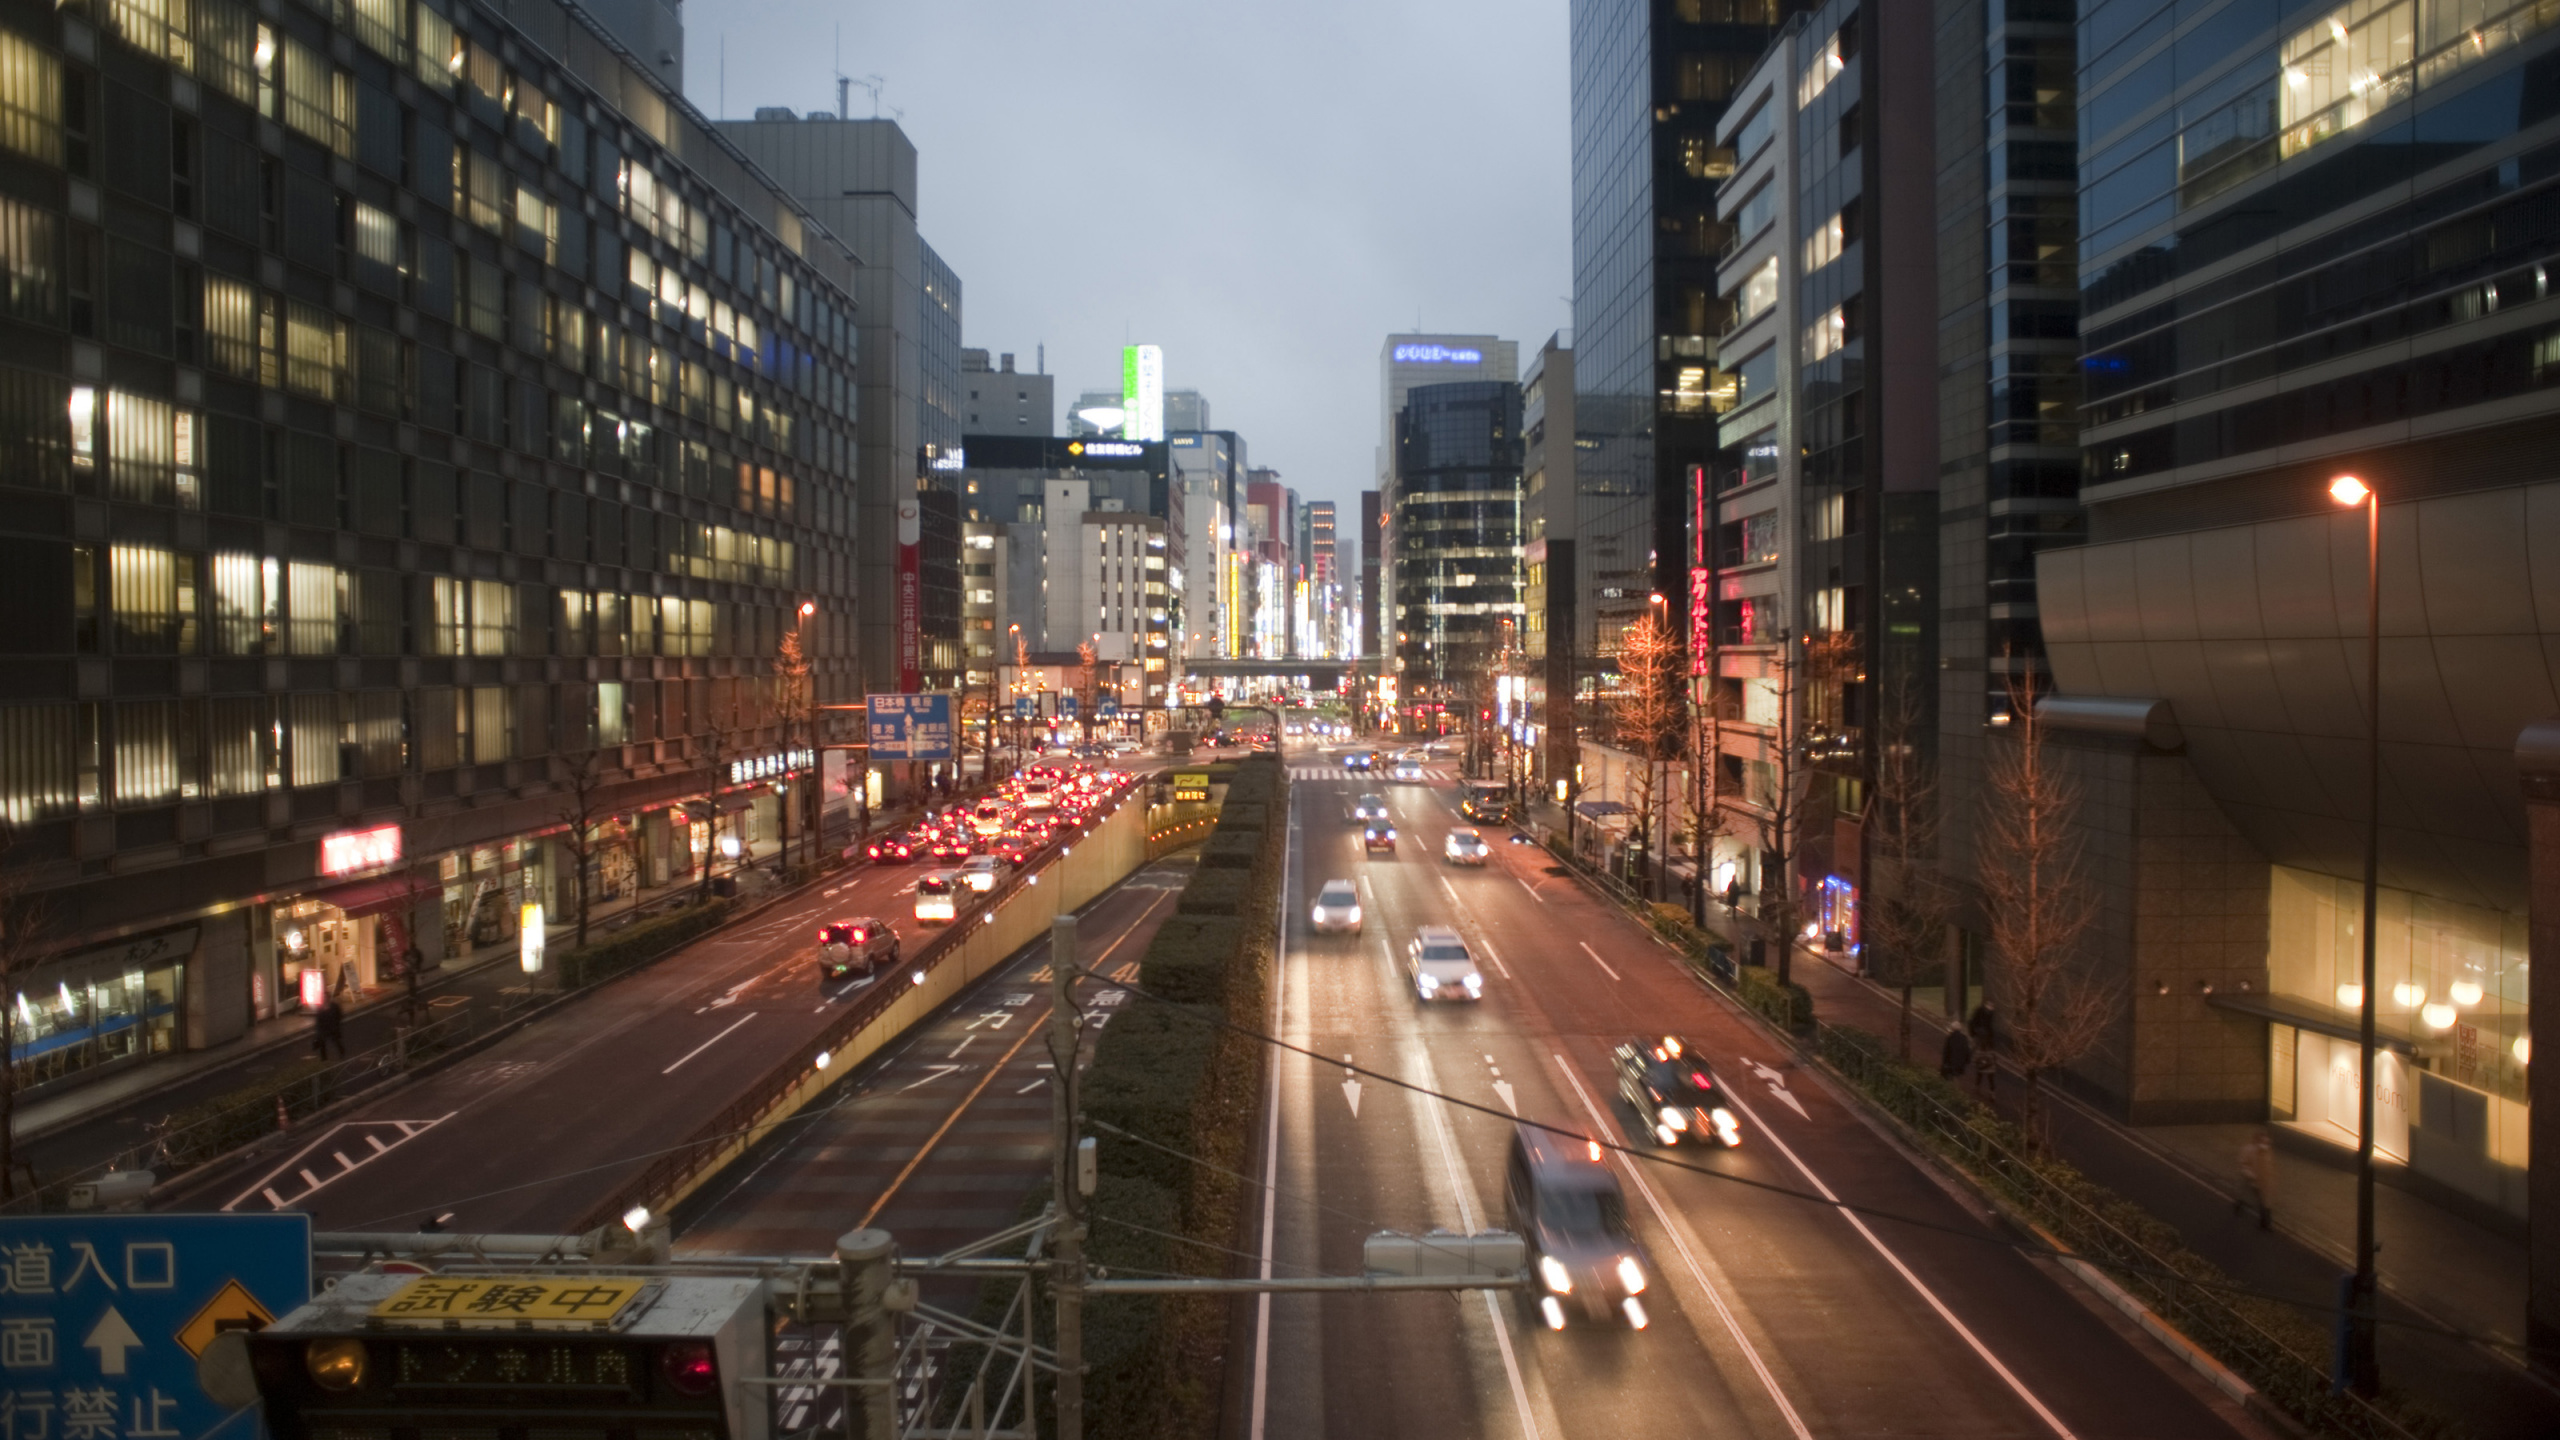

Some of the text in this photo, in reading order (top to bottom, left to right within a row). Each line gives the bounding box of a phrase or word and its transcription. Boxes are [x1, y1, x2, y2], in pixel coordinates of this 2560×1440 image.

[902, 572, 915, 670] 中央三井信託銀行
[0, 1241, 175, 1295] 道入口
[387, 1283, 625, 1313] 試験中
[402, 1347, 627, 1385] トンネル内
[0, 1386, 181, 1440] 行禁止
